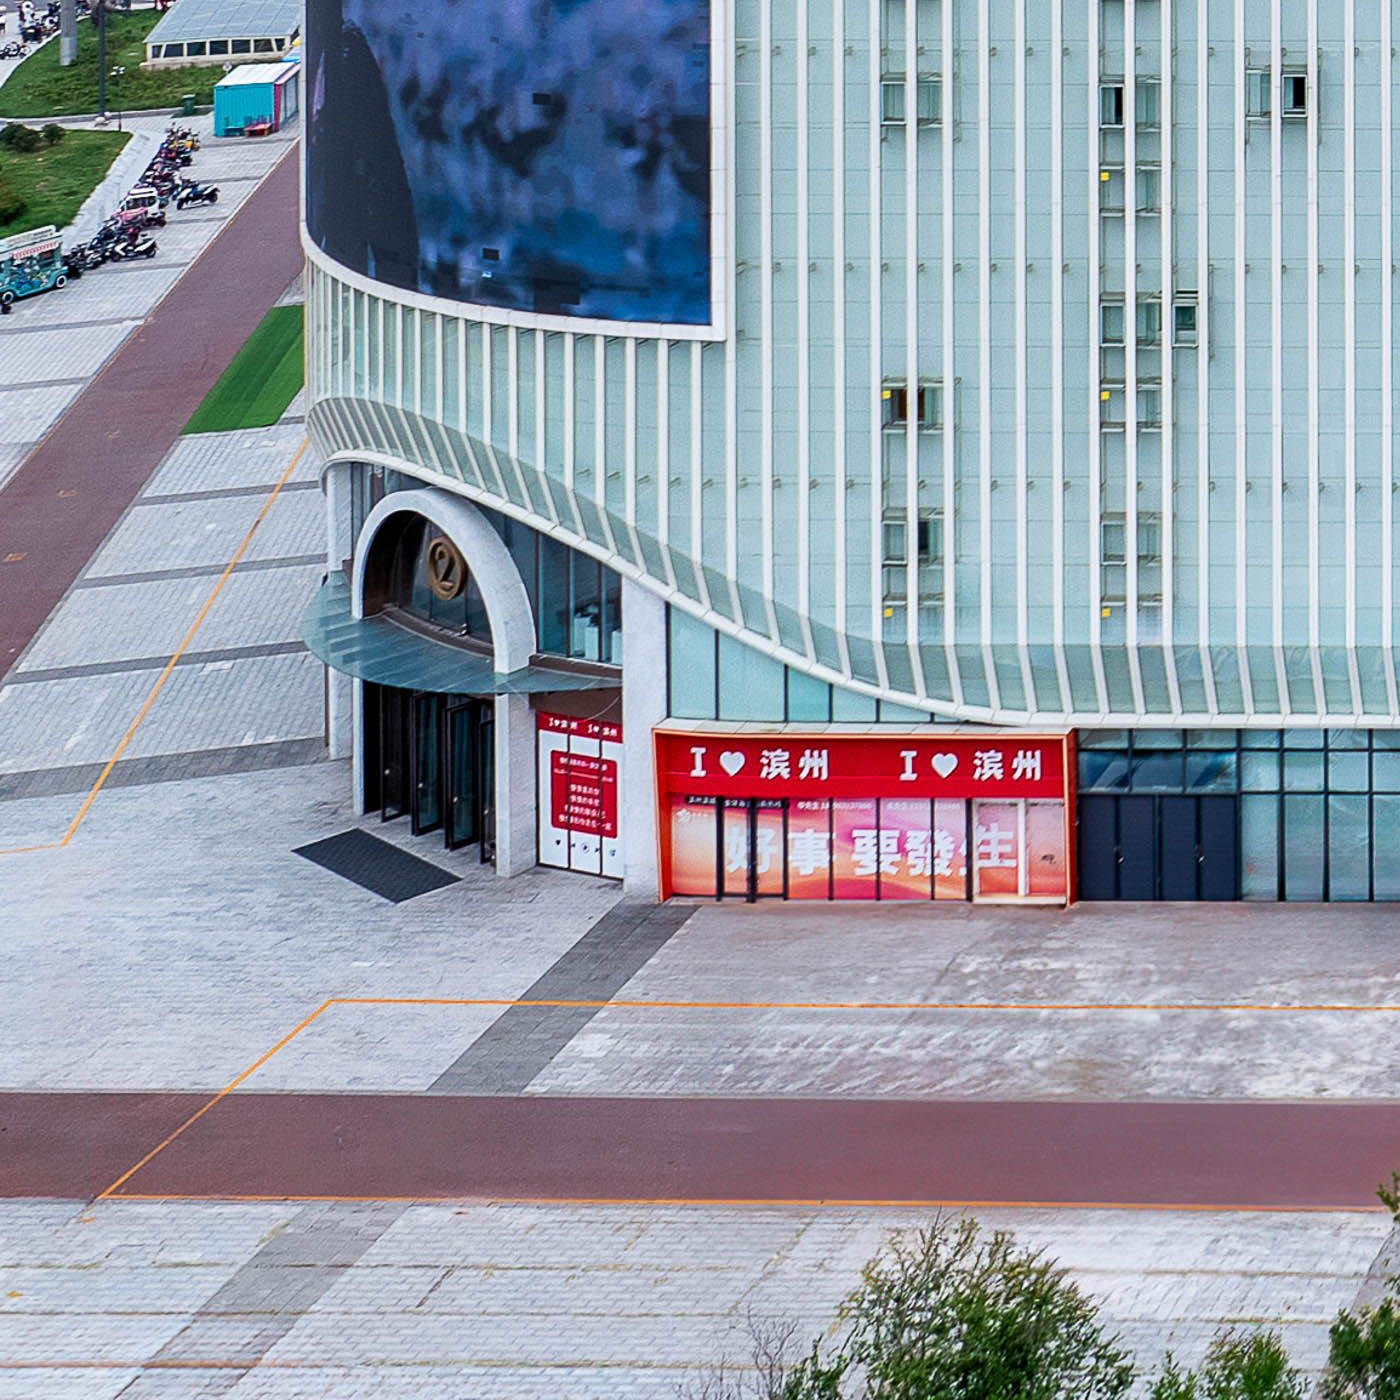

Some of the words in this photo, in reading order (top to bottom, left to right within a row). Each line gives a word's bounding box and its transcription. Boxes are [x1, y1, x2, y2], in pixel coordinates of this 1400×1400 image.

[690, 747, 707, 777] I
[760, 748, 829, 781] 滨州
[900, 750, 918, 781] I
[973, 750, 1042, 781] 滨州
